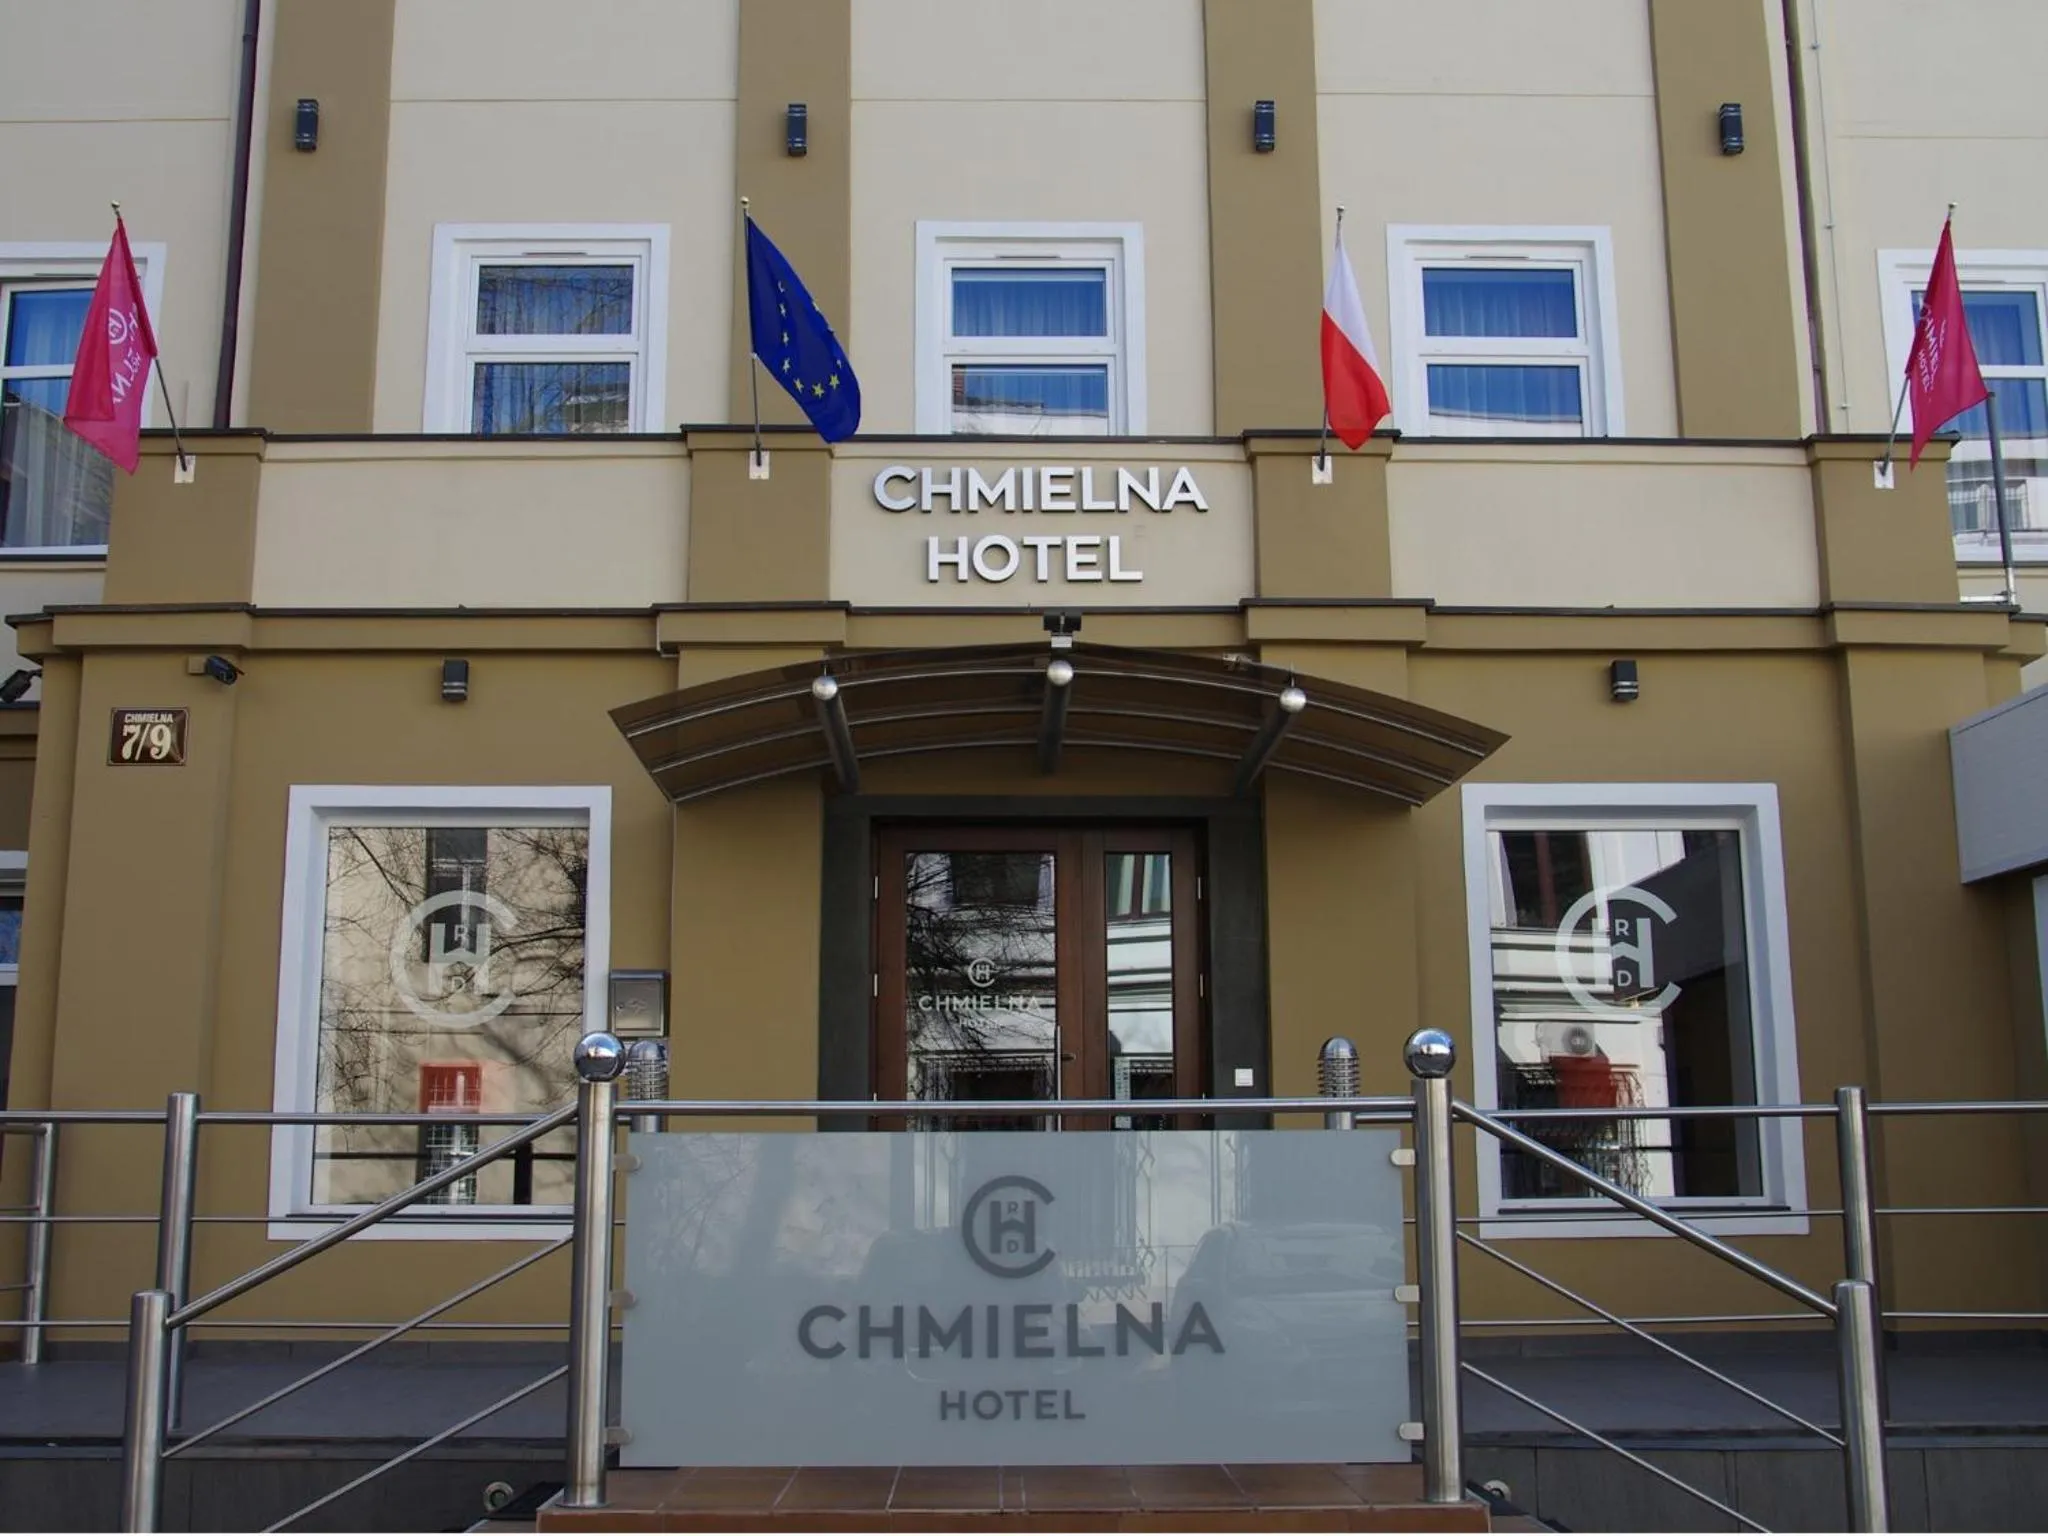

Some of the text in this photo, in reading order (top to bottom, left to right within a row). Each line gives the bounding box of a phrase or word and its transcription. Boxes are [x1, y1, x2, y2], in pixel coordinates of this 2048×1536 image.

[872, 465, 1209, 513] CHMIELNA
[927, 534, 1144, 583] HOTEL
[124, 713, 174, 723] CHMIELNA
[122, 723, 171, 760] 7/9
[918, 994, 1040, 1012] CHMIELNA
[798, 1301, 1226, 1360] CHMIELNA
[940, 1389, 1086, 1421] HOTEL
